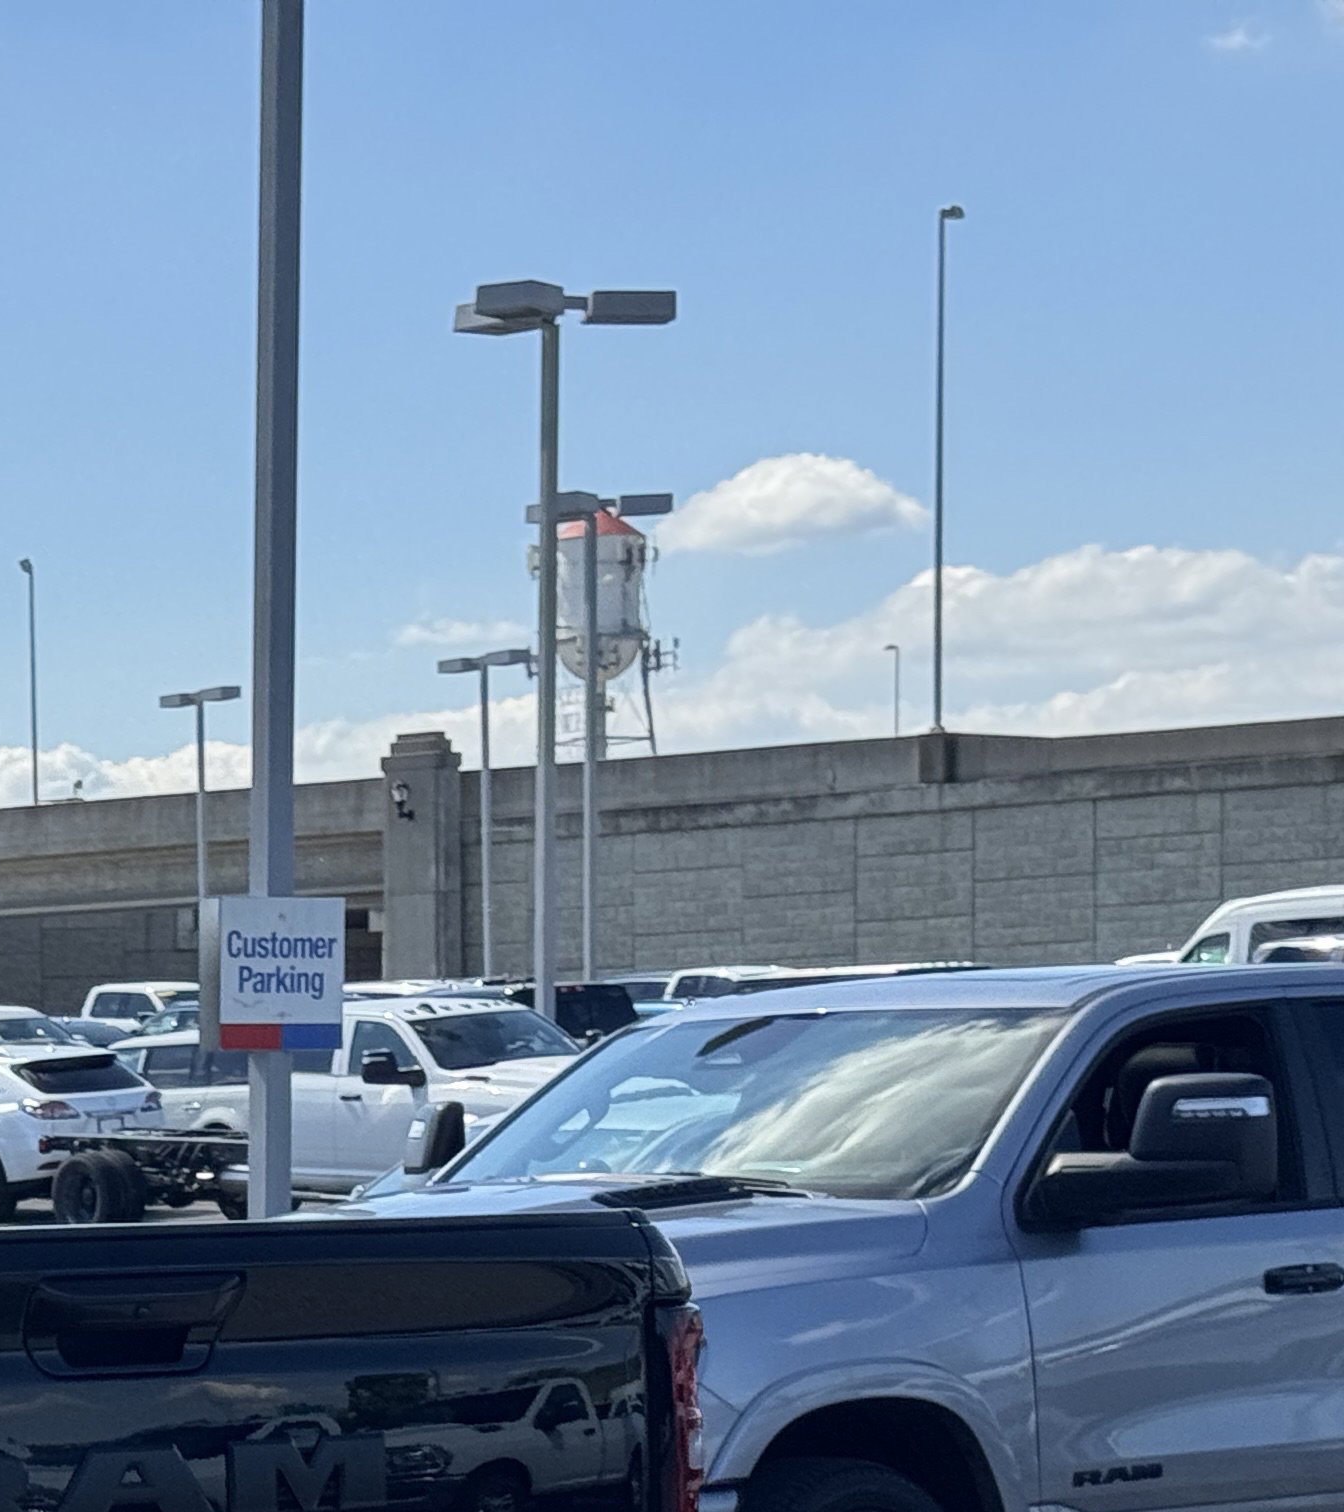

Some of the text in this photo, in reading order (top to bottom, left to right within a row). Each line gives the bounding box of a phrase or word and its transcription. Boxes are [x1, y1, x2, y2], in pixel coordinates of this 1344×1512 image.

[227, 930, 338, 959] Customer
[238, 965, 324, 1000] Parking
[1072, 1463, 1164, 1488] RAM
